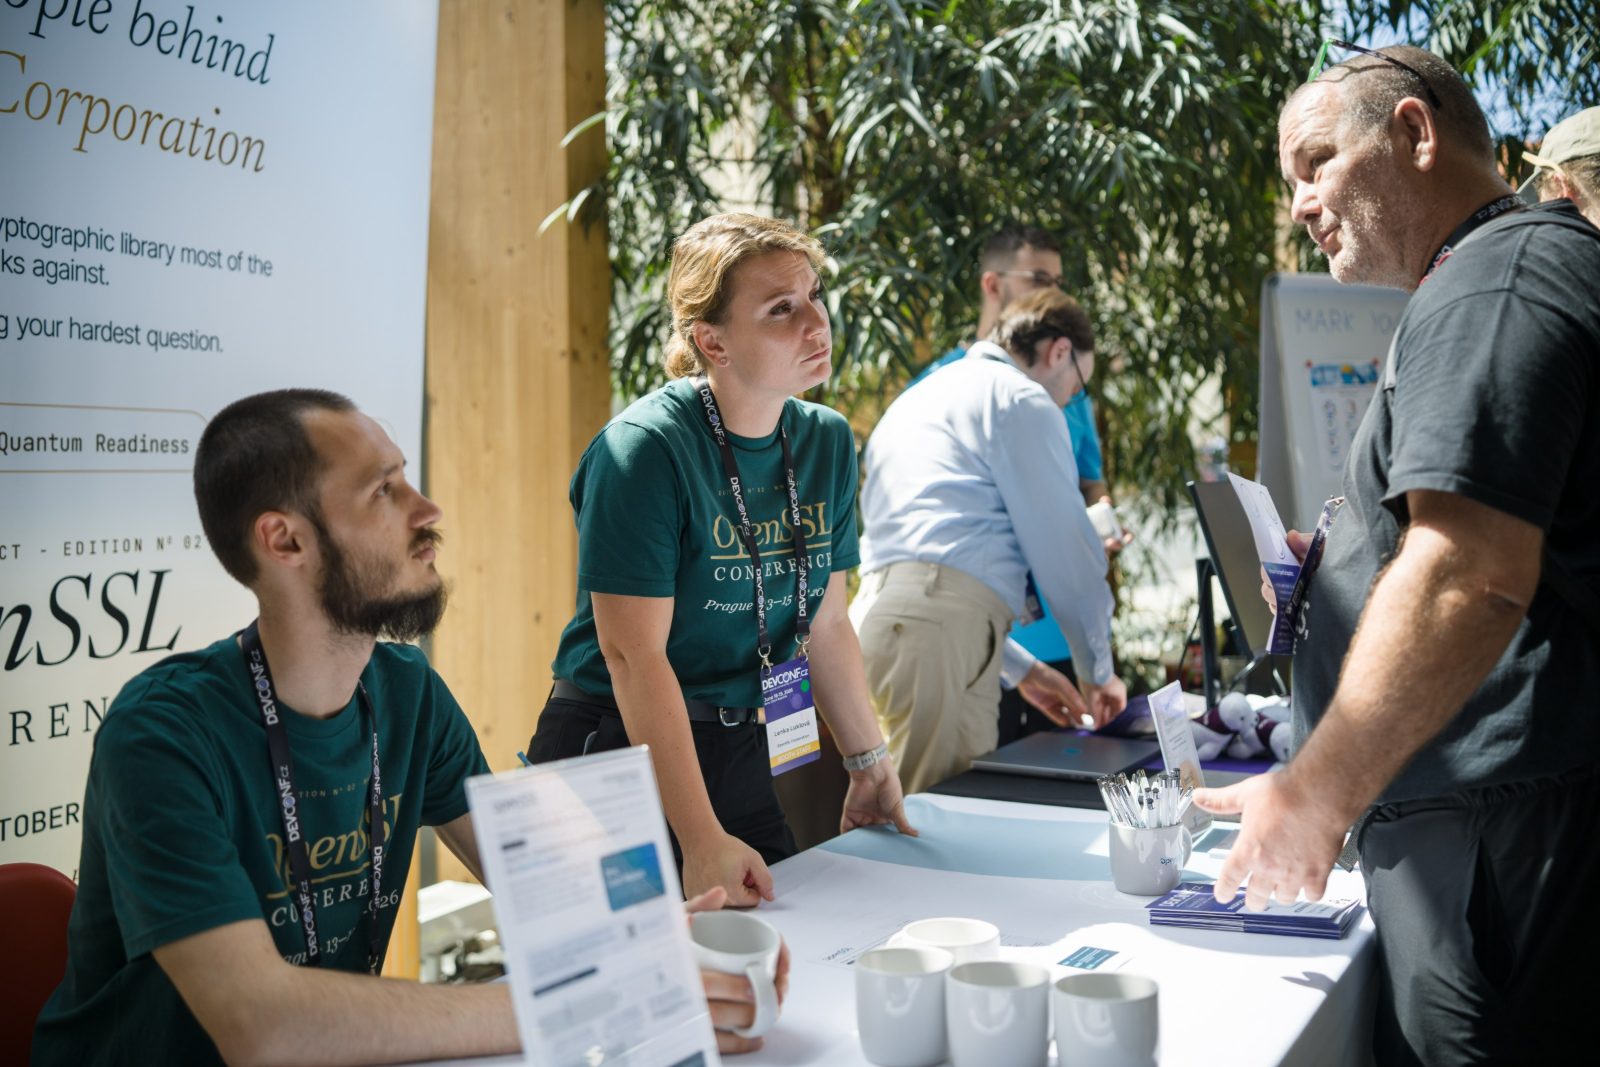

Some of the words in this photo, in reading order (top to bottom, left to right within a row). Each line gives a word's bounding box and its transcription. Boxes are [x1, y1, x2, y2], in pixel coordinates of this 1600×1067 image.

[129, 0, 275, 84] behind
[120, 232, 175, 266] library
[181, 246, 222, 269] most
[227, 251, 244, 271] of
[248, 253, 273, 276] the
[32, 258, 110, 285] against.
[16, 316, 62, 340] your
[69, 316, 141, 345] hardest
[147, 329, 223, 352] question.
[1295, 308, 1353, 334] MARK
[0, 432, 82, 456] Quantum
[96, 434, 190, 453] Readiness
[0, 544, 21, 560] CT
[63, 538, 142, 556] EDITION
[184, 535, 201, 549] 02
[704, 599, 753, 614] Prague
[0, 802, 80, 842] TOBER
